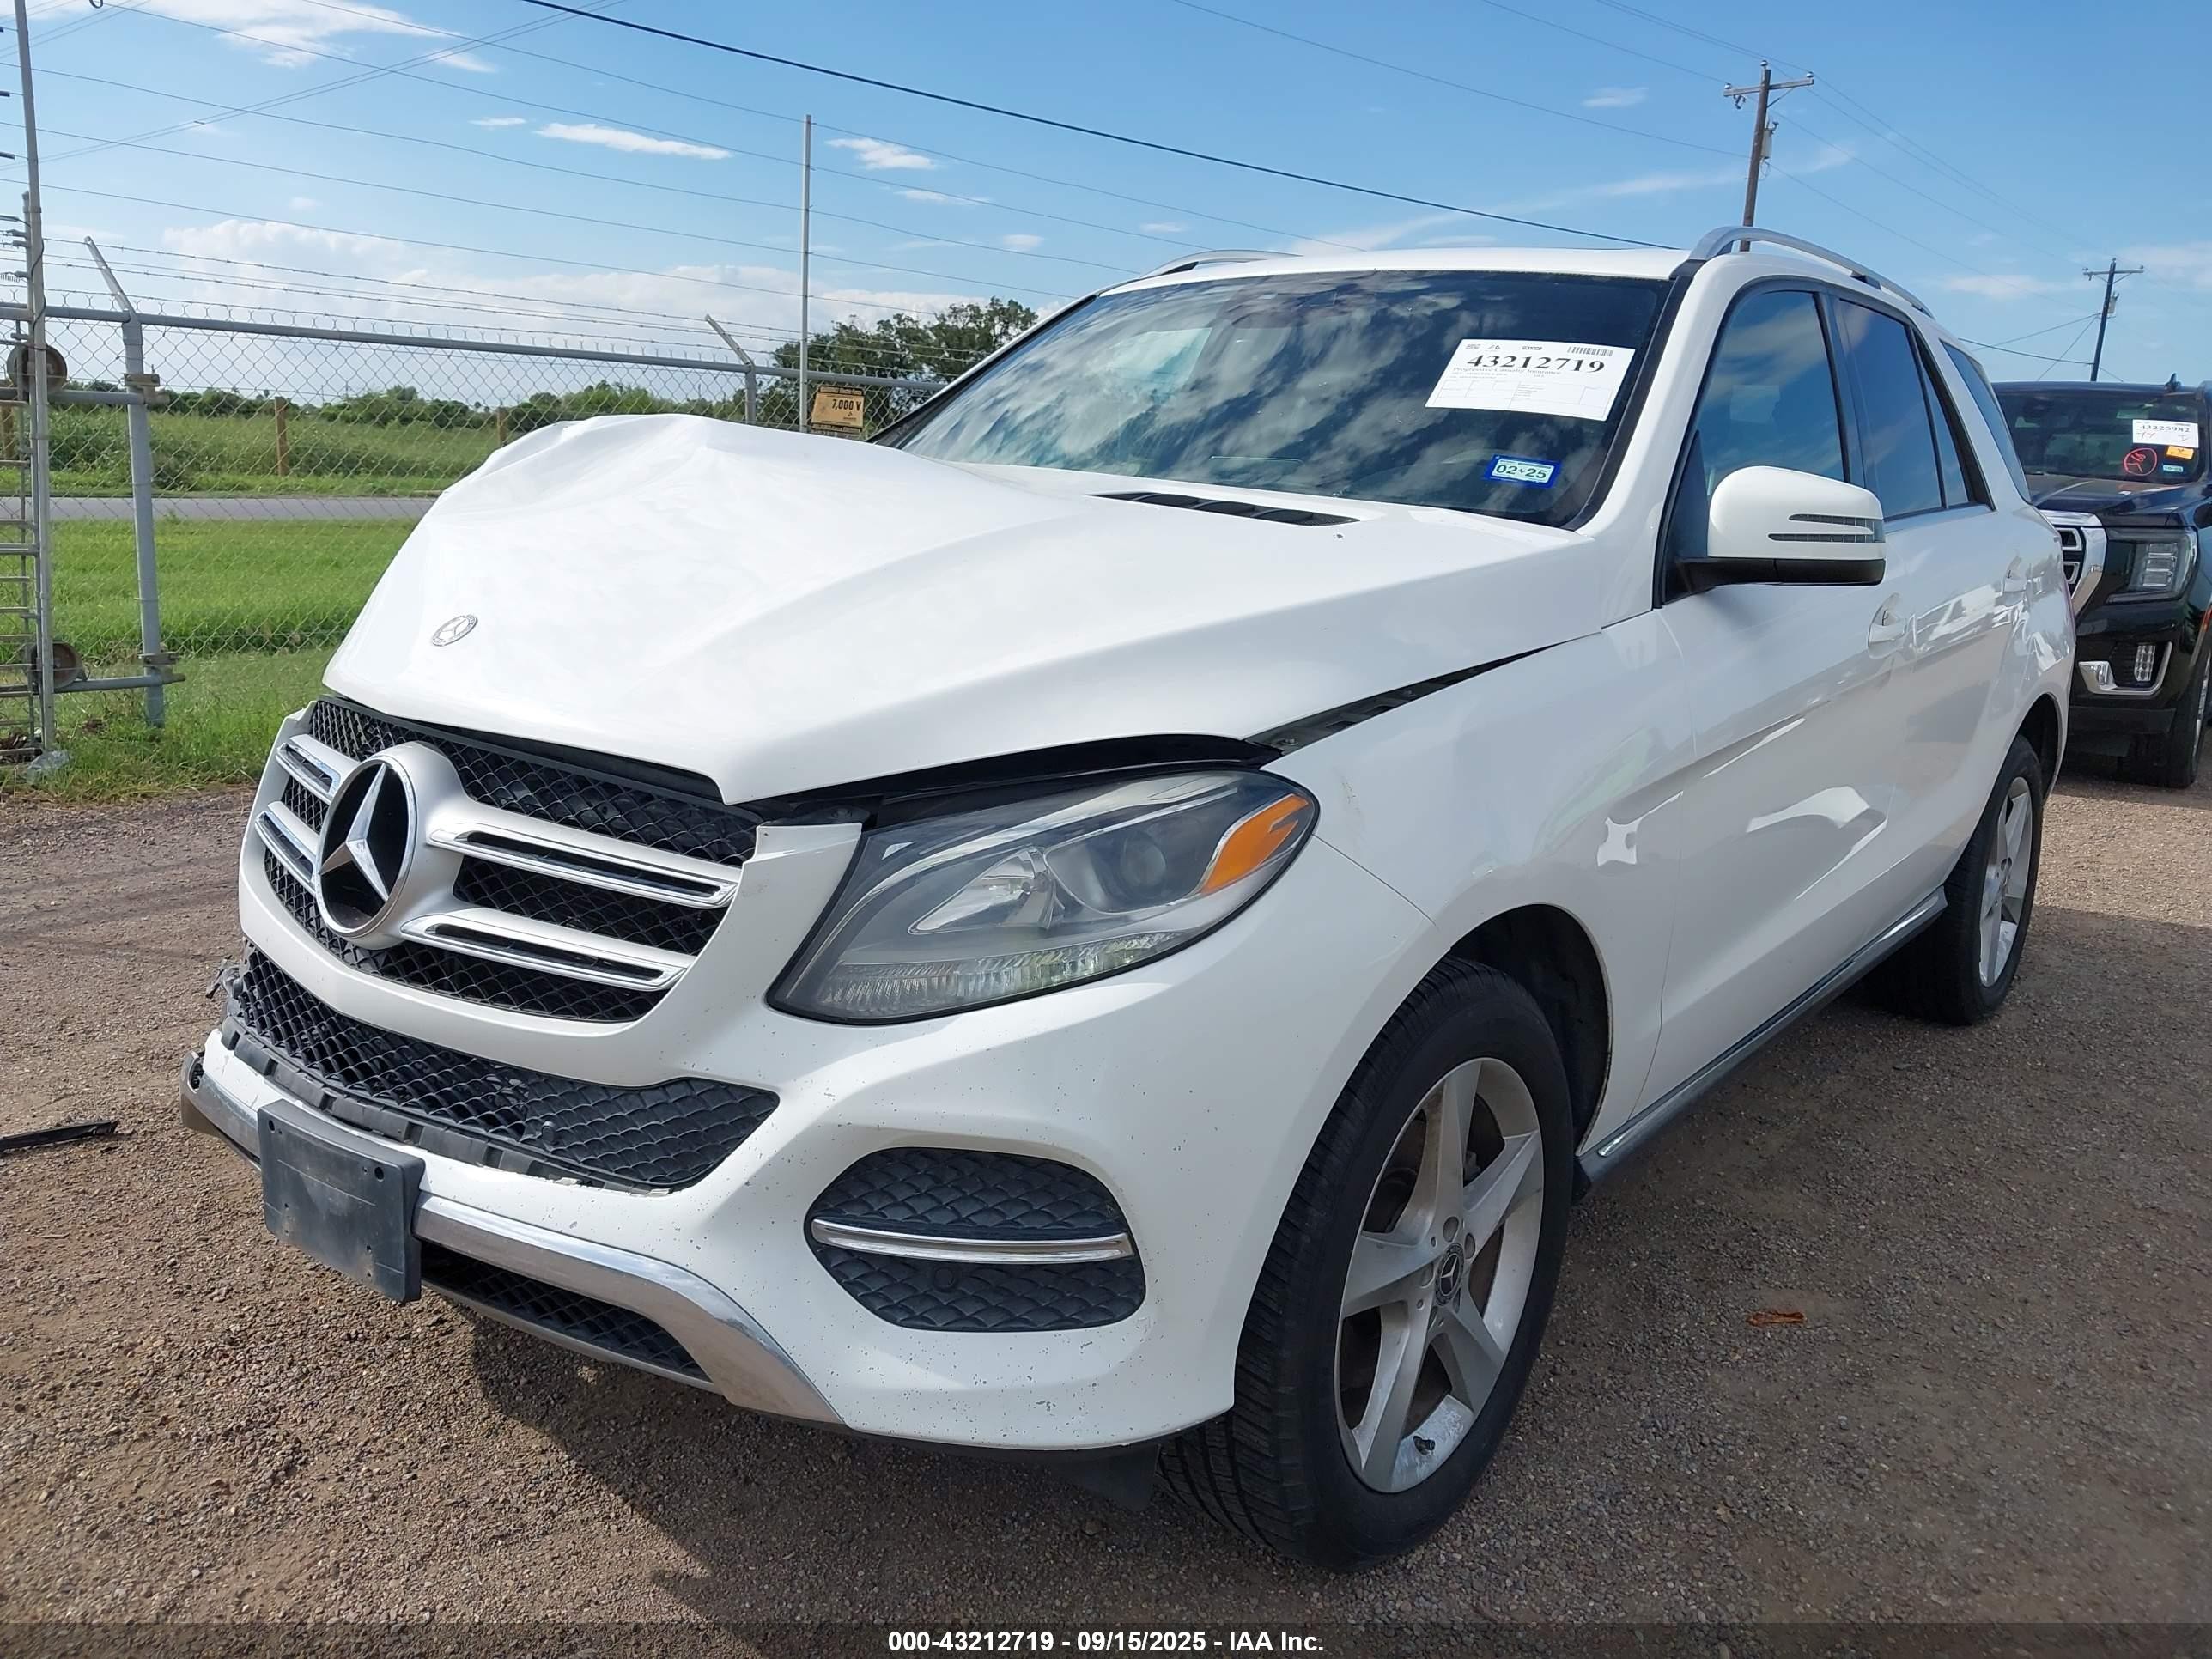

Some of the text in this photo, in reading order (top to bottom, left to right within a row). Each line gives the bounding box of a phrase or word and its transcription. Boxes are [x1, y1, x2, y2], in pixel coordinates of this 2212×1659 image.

[1467, 355, 1605, 373] 43212719
[832, 399, 861, 411] 7,000 V
